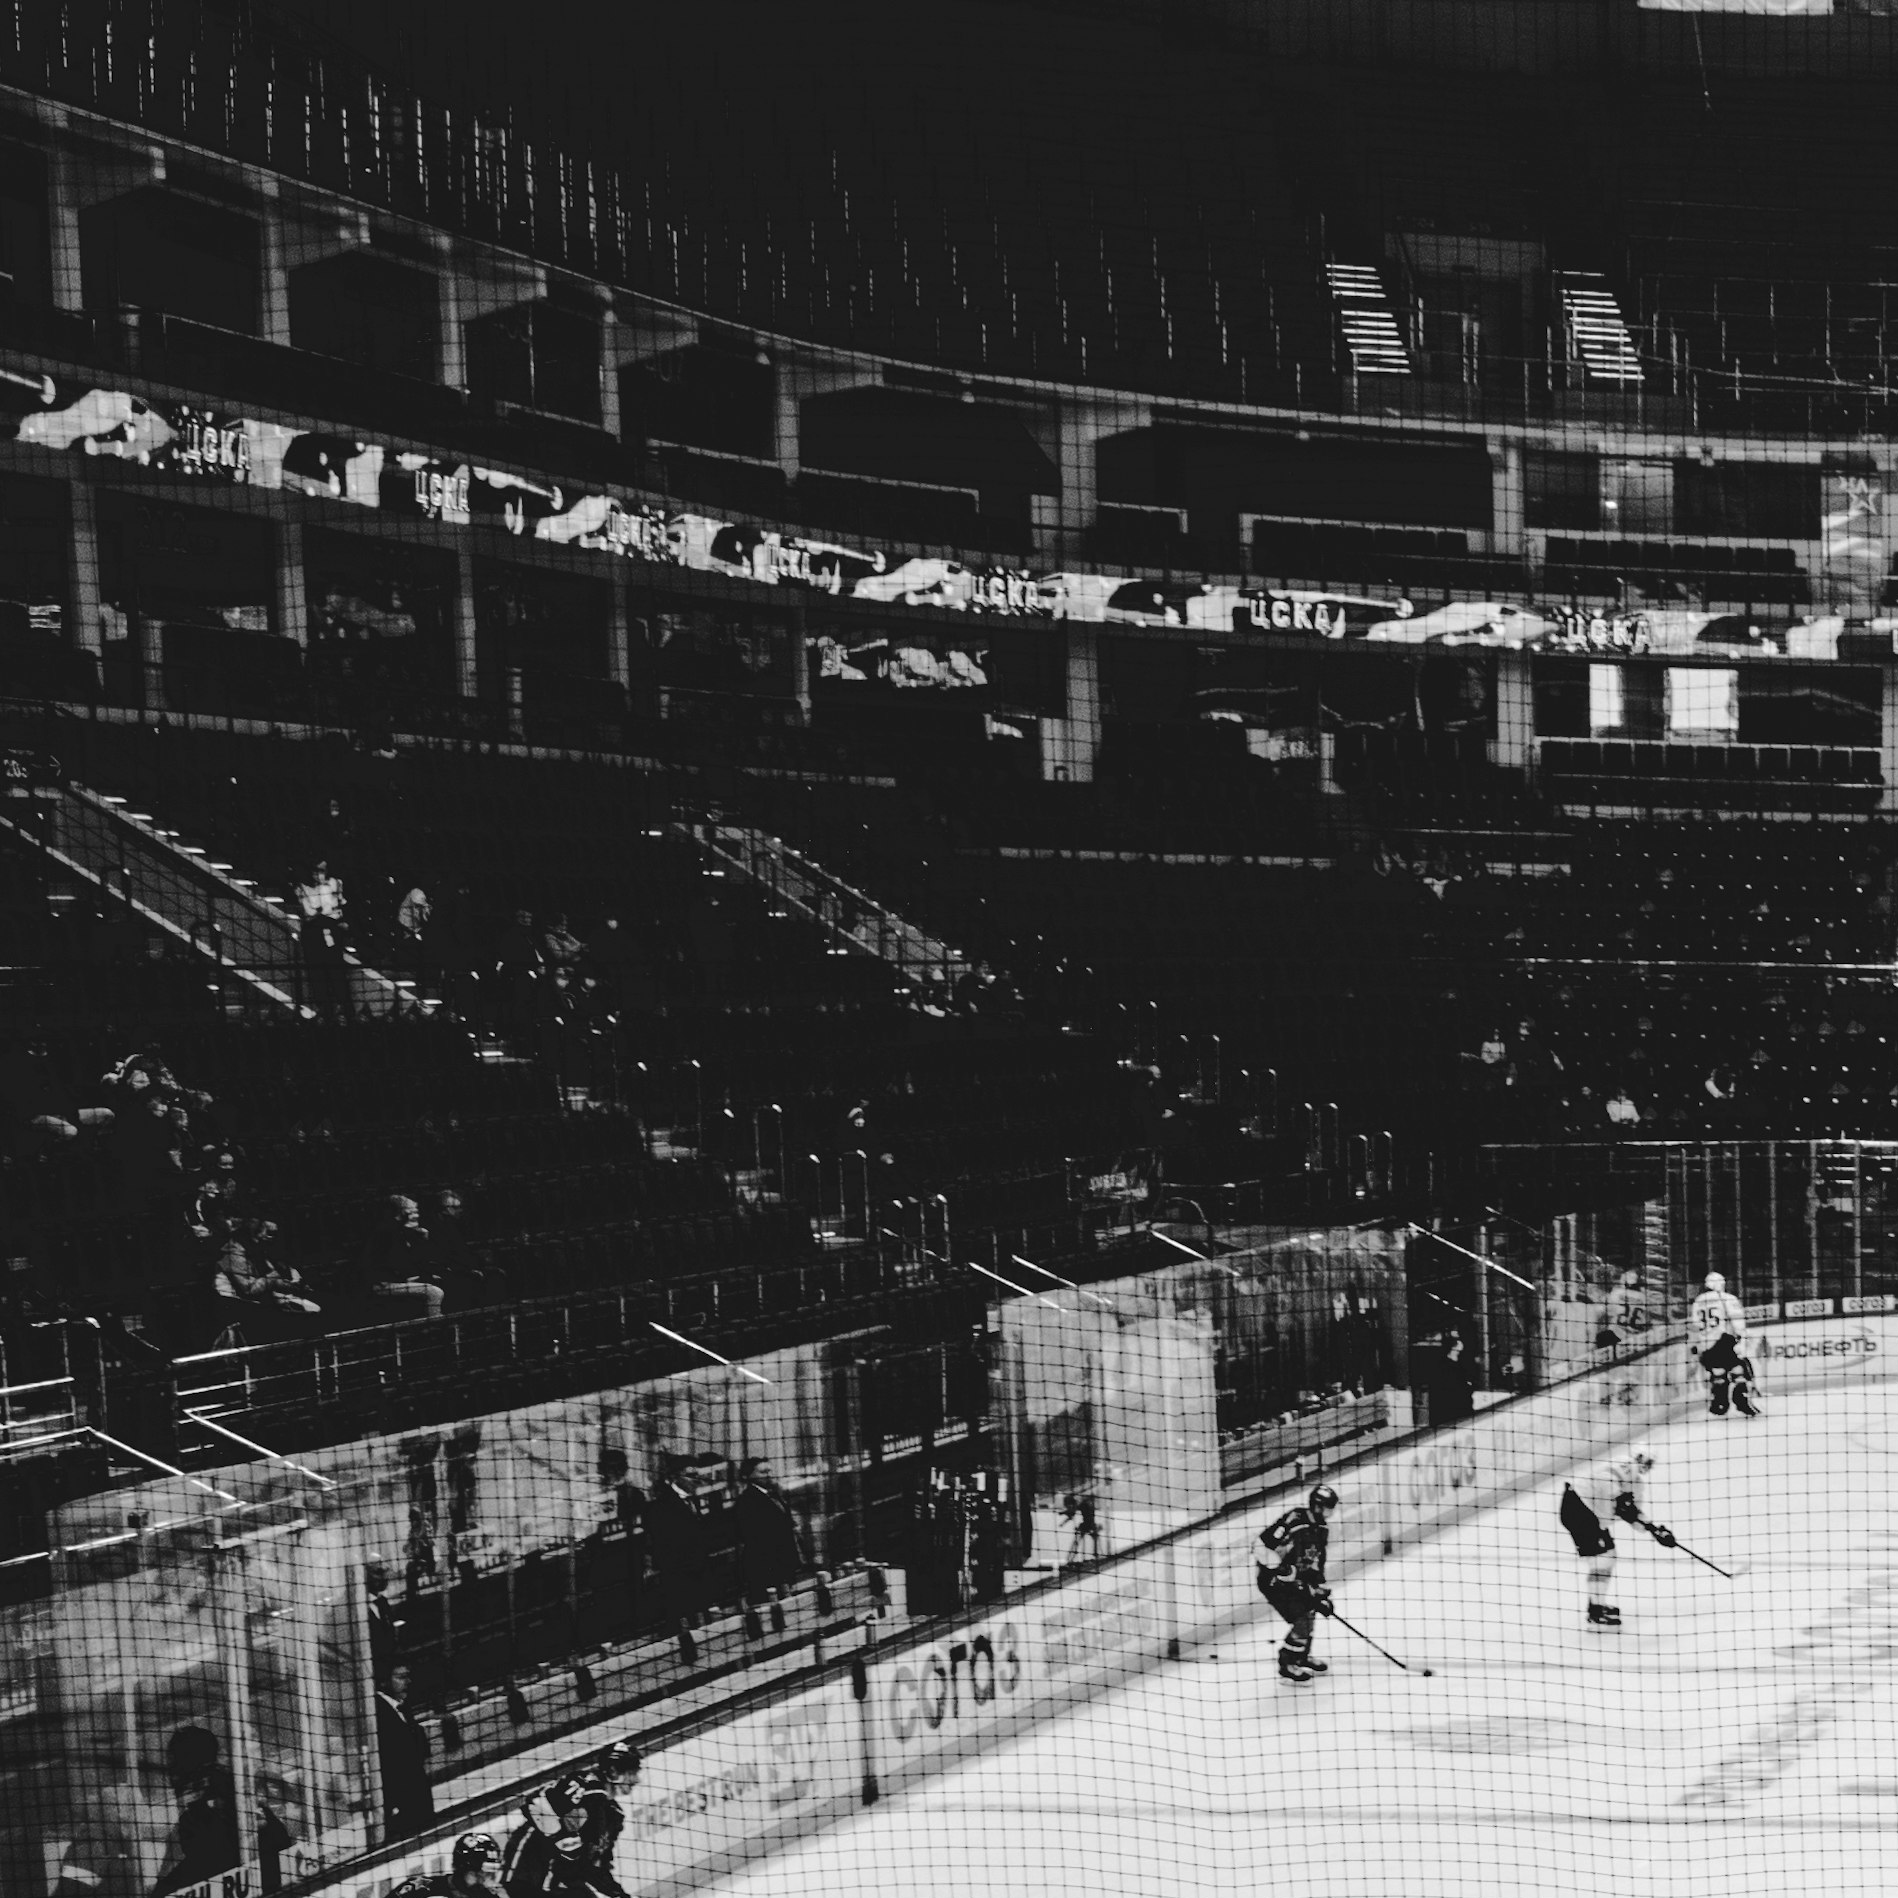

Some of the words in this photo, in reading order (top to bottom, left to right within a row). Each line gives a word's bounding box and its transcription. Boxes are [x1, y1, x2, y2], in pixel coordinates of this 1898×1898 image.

[416, 471, 470, 513] ЦСКА
[974, 576, 1039, 608] ЦСКА
[1250, 600, 1328, 631] ЦСКА
[1567, 619, 1651, 652] ЦСКА
[1697, 1306, 1720, 1332] 35
[1848, 1296, 1888, 1311] согаз
[1774, 1337, 1878, 1360] РОСНЕФТЬ
[890, 1622, 1021, 1745] согаз
